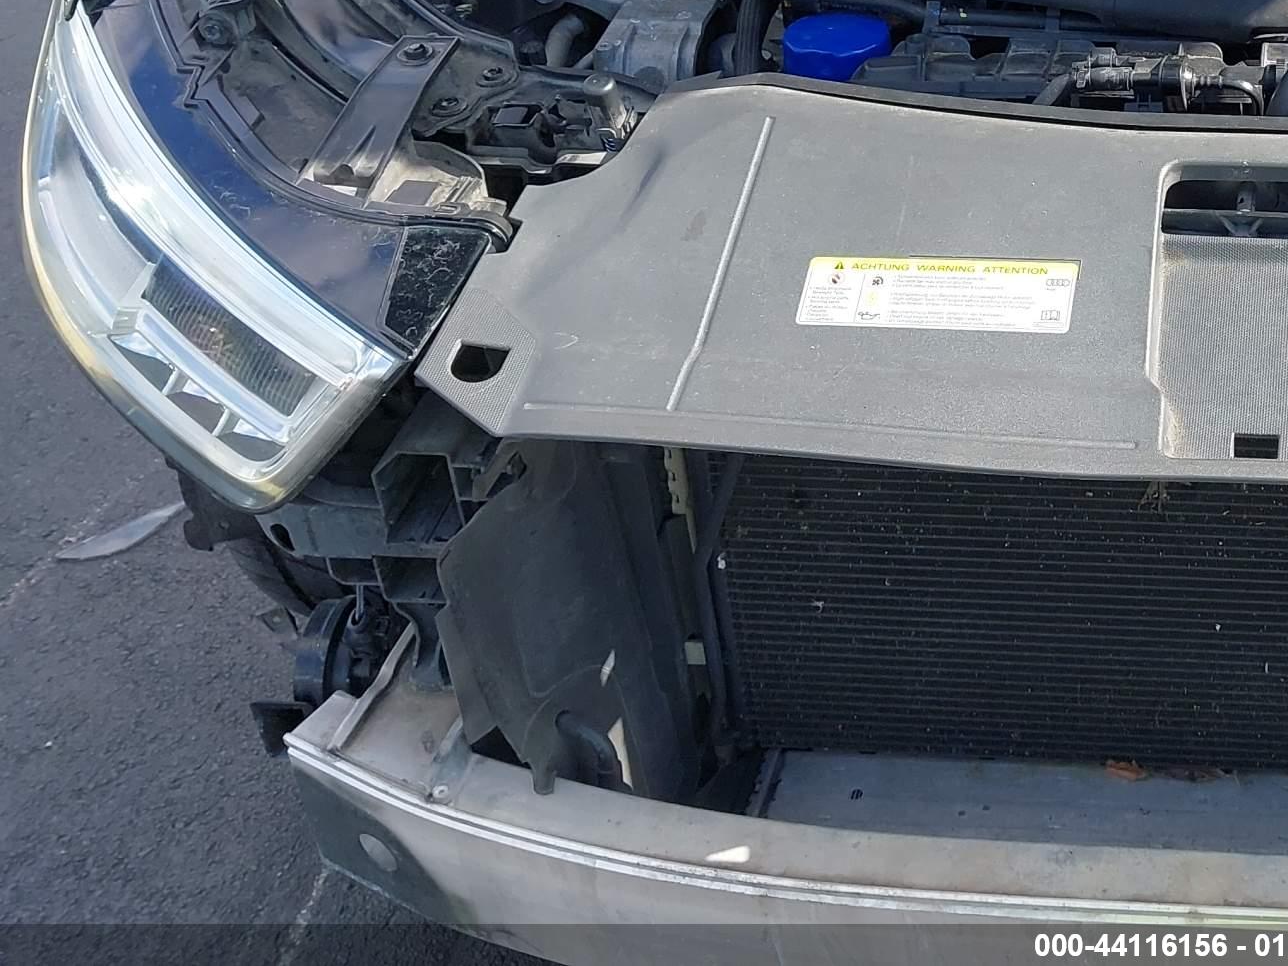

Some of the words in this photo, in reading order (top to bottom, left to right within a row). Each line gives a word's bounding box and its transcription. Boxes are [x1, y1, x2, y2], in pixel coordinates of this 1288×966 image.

[852, 262, 909, 271] ACHTUNG
[917, 264, 975, 273] WARNING
[982, 266, 1048, 275] ATTENTION
